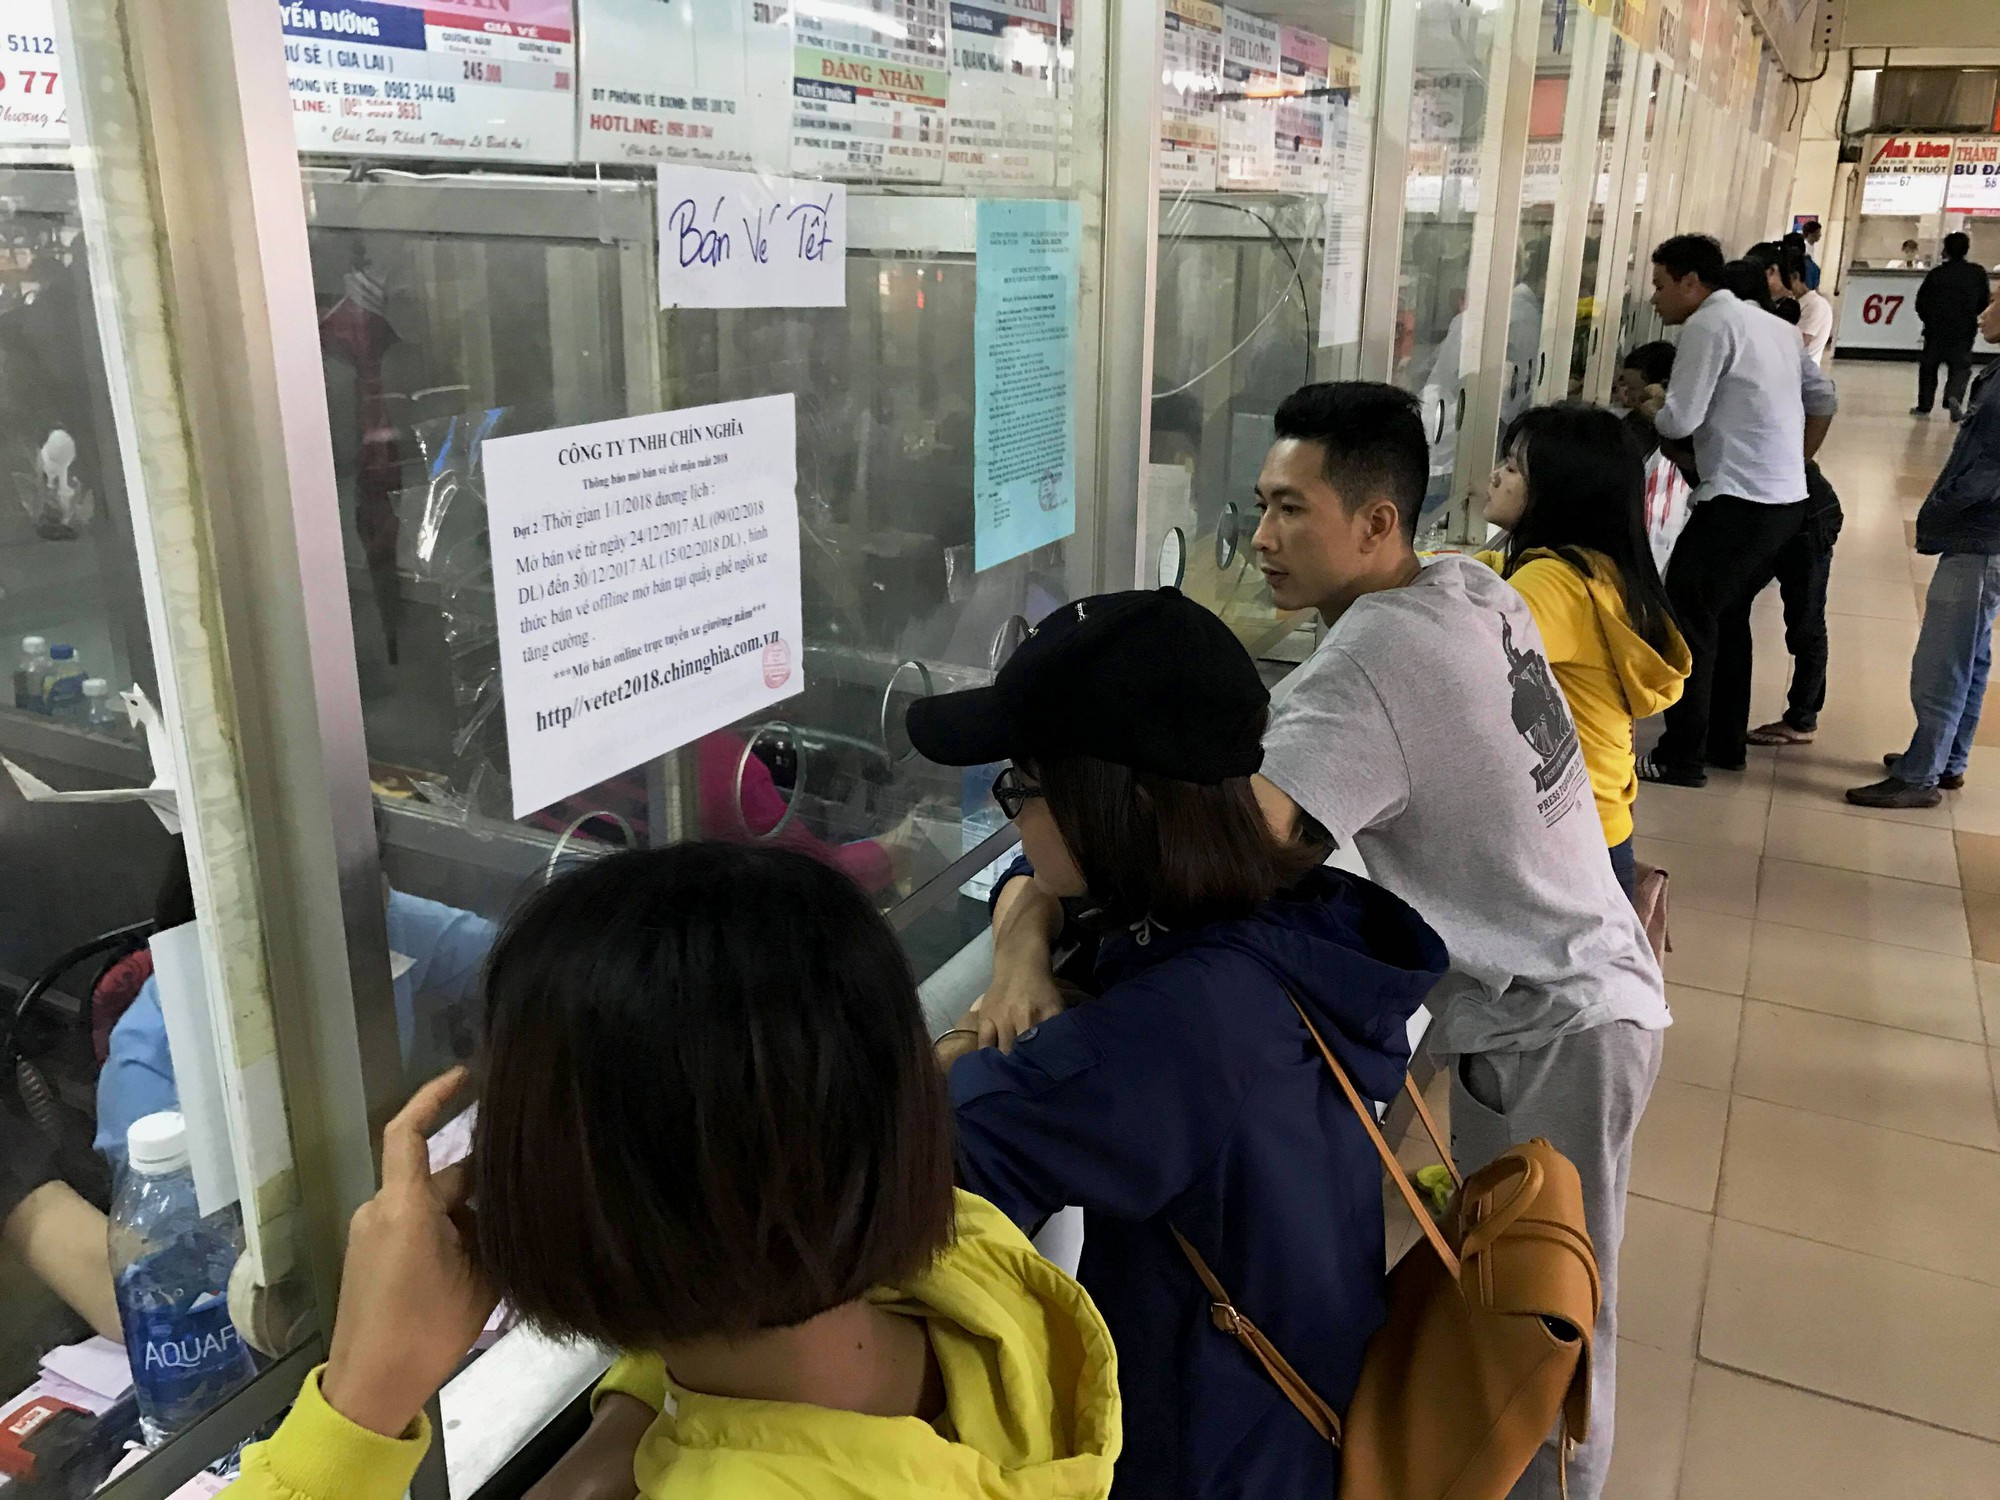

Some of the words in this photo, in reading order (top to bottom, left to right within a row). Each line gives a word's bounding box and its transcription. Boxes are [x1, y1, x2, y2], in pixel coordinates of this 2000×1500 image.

[280, 1, 317, 29] YẾN
[320, 9, 380, 37] ĐƯỜNG
[293, 98, 332, 114] LINE:
[590, 114, 663, 135] HOTLINE:
[669, 196, 731, 268] Bán
[742, 203, 781, 264] Vé
[786, 193, 833, 262] Tết
[1862, 294, 1904, 325] 67
[558, 442, 602, 466] CÔNG
[605, 439, 624, 457] TY
[629, 433, 667, 454] TNHH
[582, 476, 609, 490] Thông
[610, 471, 626, 485] báo
[642, 467, 657, 479] bán
[713, 453, 729, 465] 2018
[513, 525, 531, 539] Đợt
[542, 509, 572, 531] Thời
[576, 506, 602, 529] gian
[605, 493, 653, 518] 1/1/2018
[690, 481, 709, 501] lịch
[541, 550, 564, 568] bán
[567, 543, 582, 560] vé
[600, 534, 626, 557] ngày
[630, 518, 689, 547] 24/12/2017
[692, 514, 708, 532] AL
[709, 500, 765, 529] (09/02/2018
[518, 583, 545, 605] DL)
[547, 573, 570, 597] đến
[572, 558, 636, 590] 30/12/2017
[640, 554, 657, 572] AL
[659, 537, 720, 568] (15/02/2018
[519, 614, 547, 634] thức
[551, 606, 573, 624] bán
[576, 599, 590, 615] vé
[592, 591, 629, 611] offline
[652, 578, 672, 595] bán
[674, 572, 687, 590] tại
[734, 550, 755, 573] ngồi
[757, 553, 768, 564] xe
[522, 644, 549, 663] tăng
[592, 656, 611, 672] bán
[614, 646, 643, 664] online
[664, 625, 689, 647] tuyến
[691, 625, 701, 636] xe
[1537, 788, 1561, 814] PRESS
